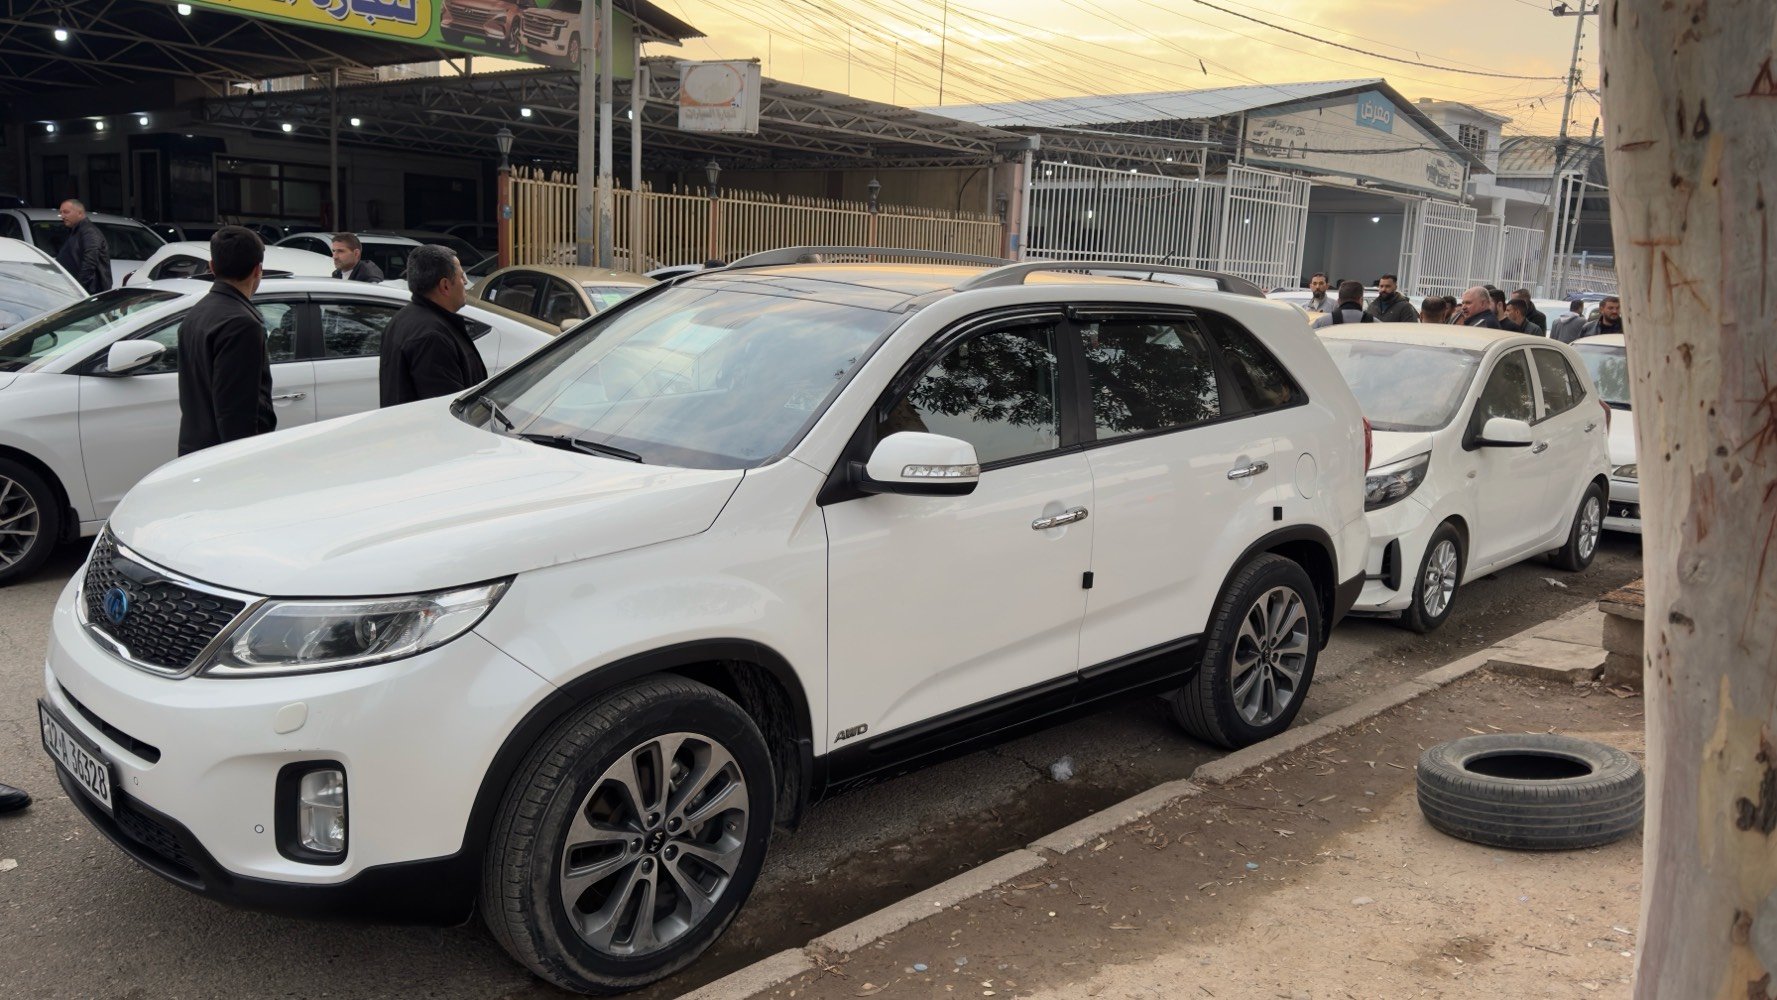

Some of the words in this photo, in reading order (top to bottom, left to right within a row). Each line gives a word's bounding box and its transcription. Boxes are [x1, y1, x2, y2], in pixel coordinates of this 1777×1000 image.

[1361, 100, 1390, 125] معرض
[834, 722, 869, 743] AWD
[69, 740, 108, 800] 36328
